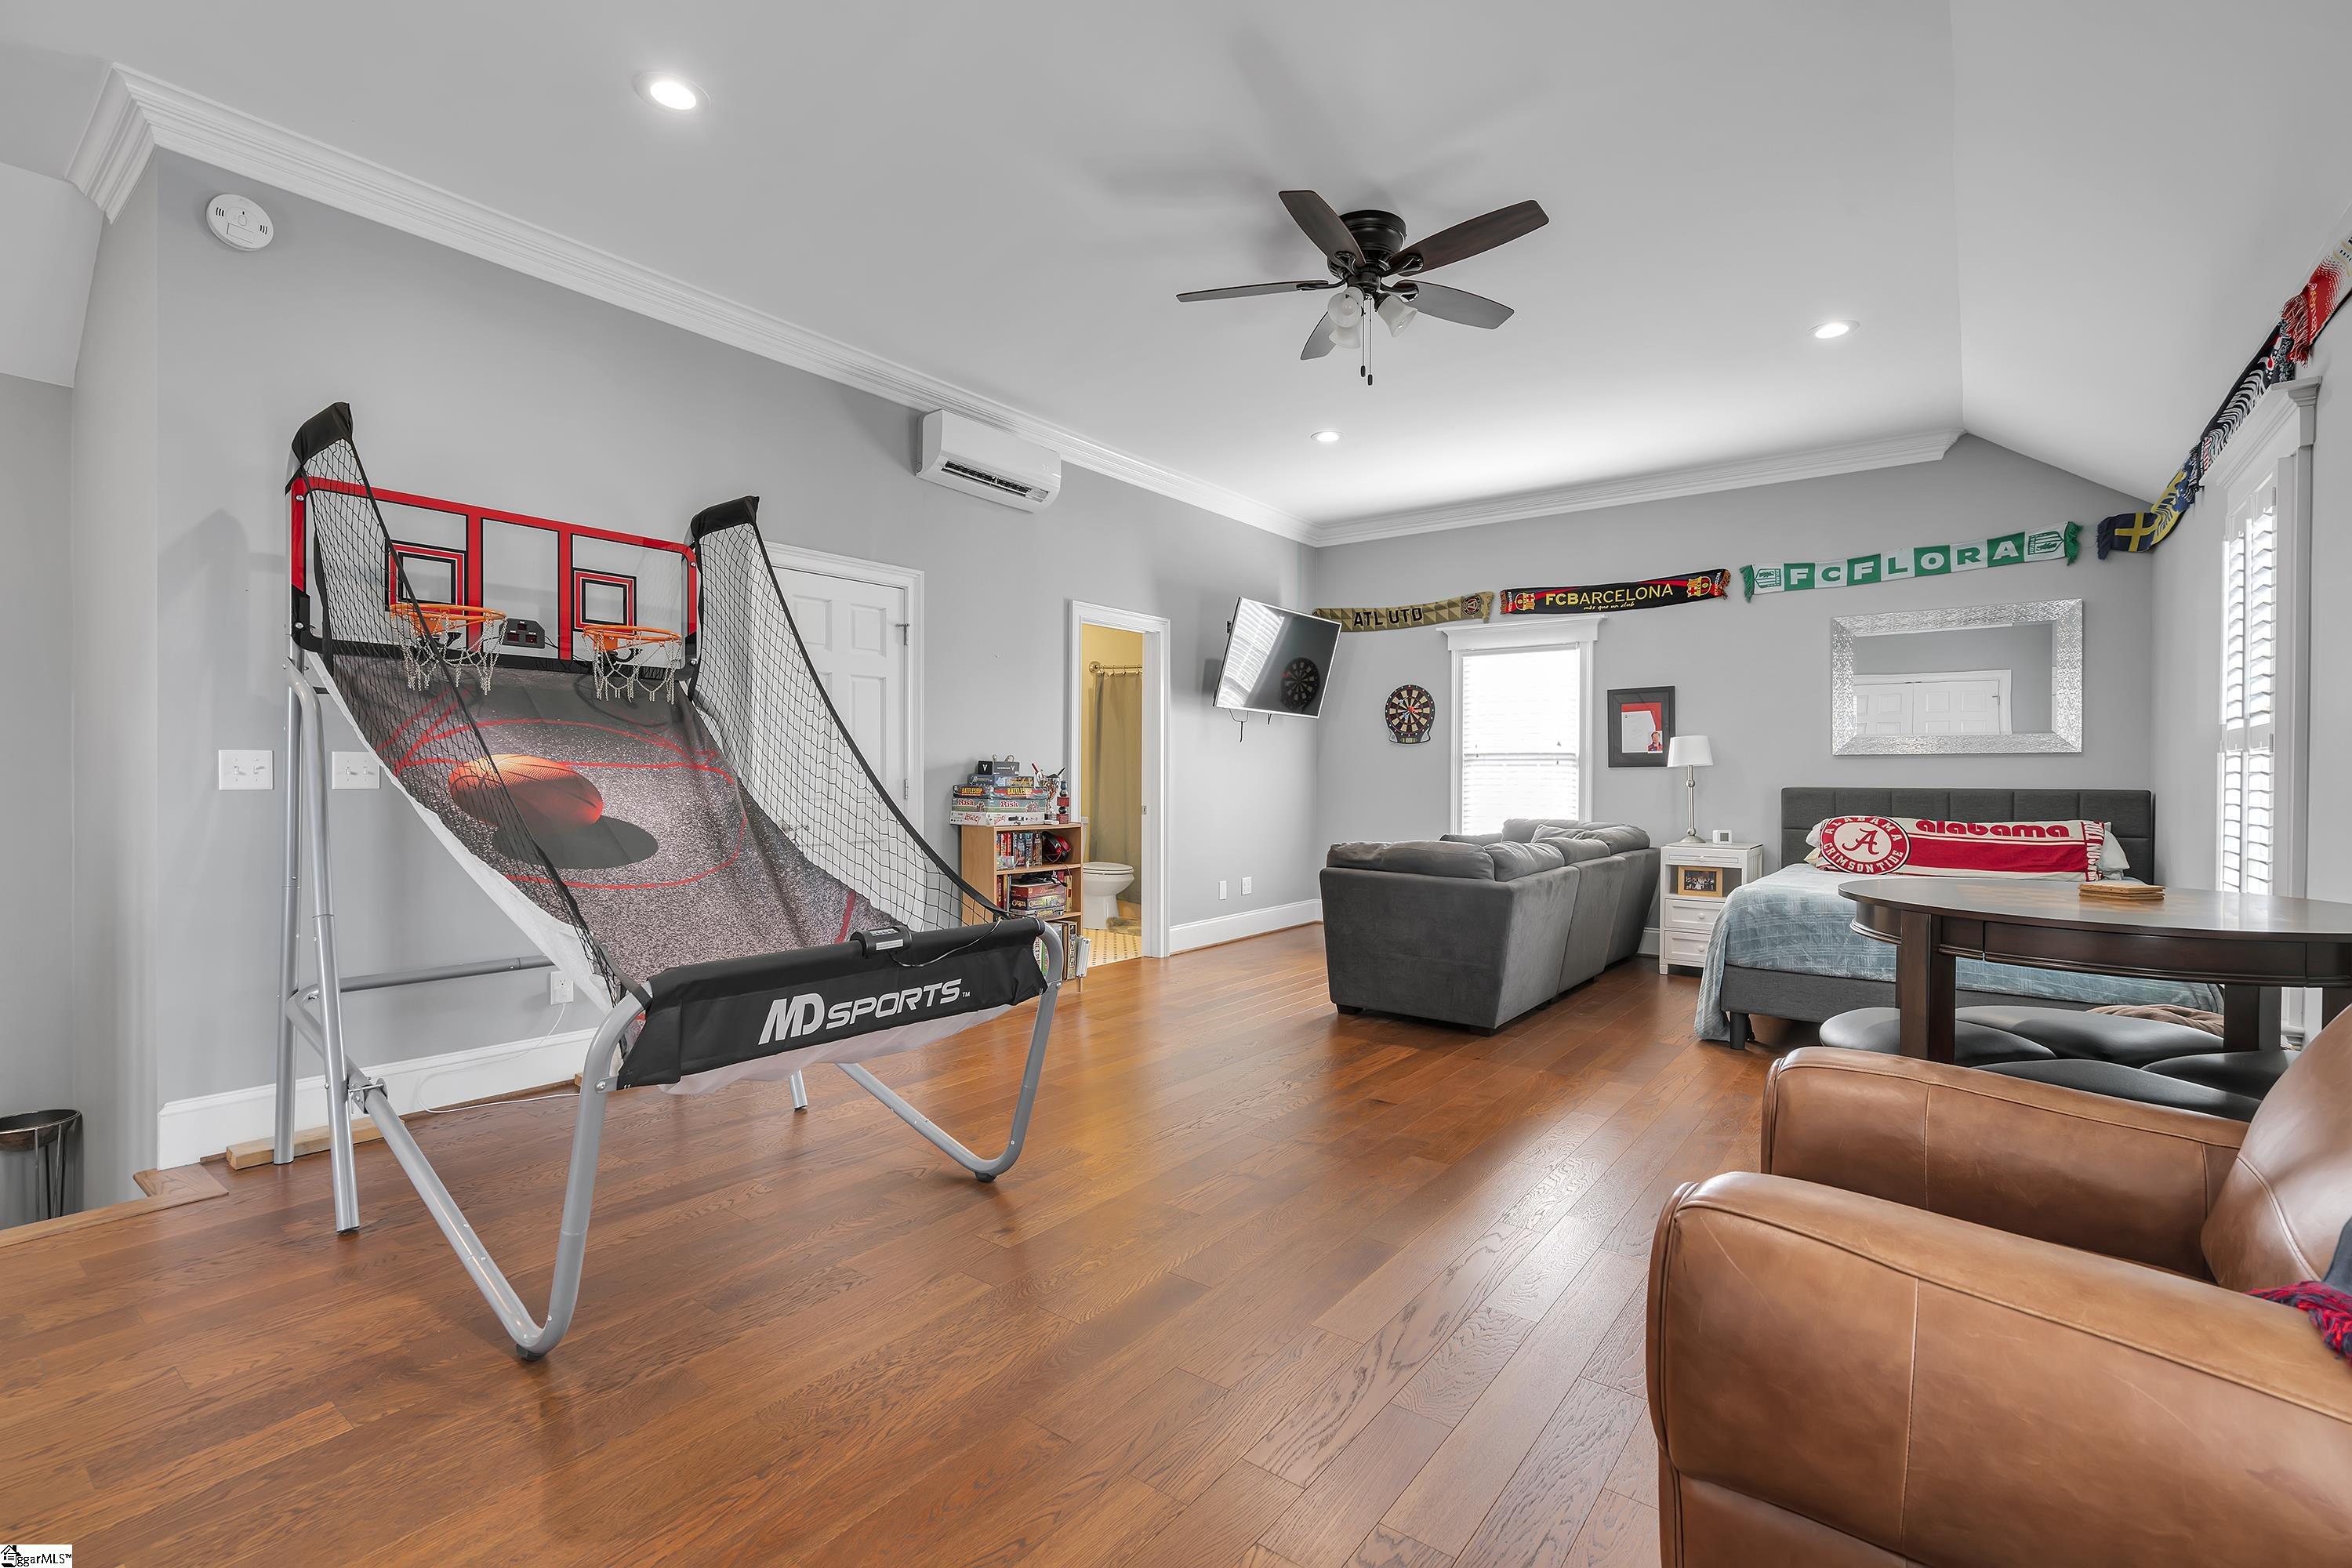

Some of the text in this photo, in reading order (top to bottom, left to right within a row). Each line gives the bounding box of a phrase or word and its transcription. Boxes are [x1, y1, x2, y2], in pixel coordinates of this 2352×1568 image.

[1545, 583, 1674, 606] FCBARCELONA
[1353, 607, 1424, 627] ATL UTD
[1824, 817, 1903, 842] ALABAMA
[1915, 819, 2070, 838] alabama
[1823, 841, 1904, 873] CRIMSON TIDE
[758, 993, 826, 1046] MD
[826, 978, 963, 1030] SPORTS
